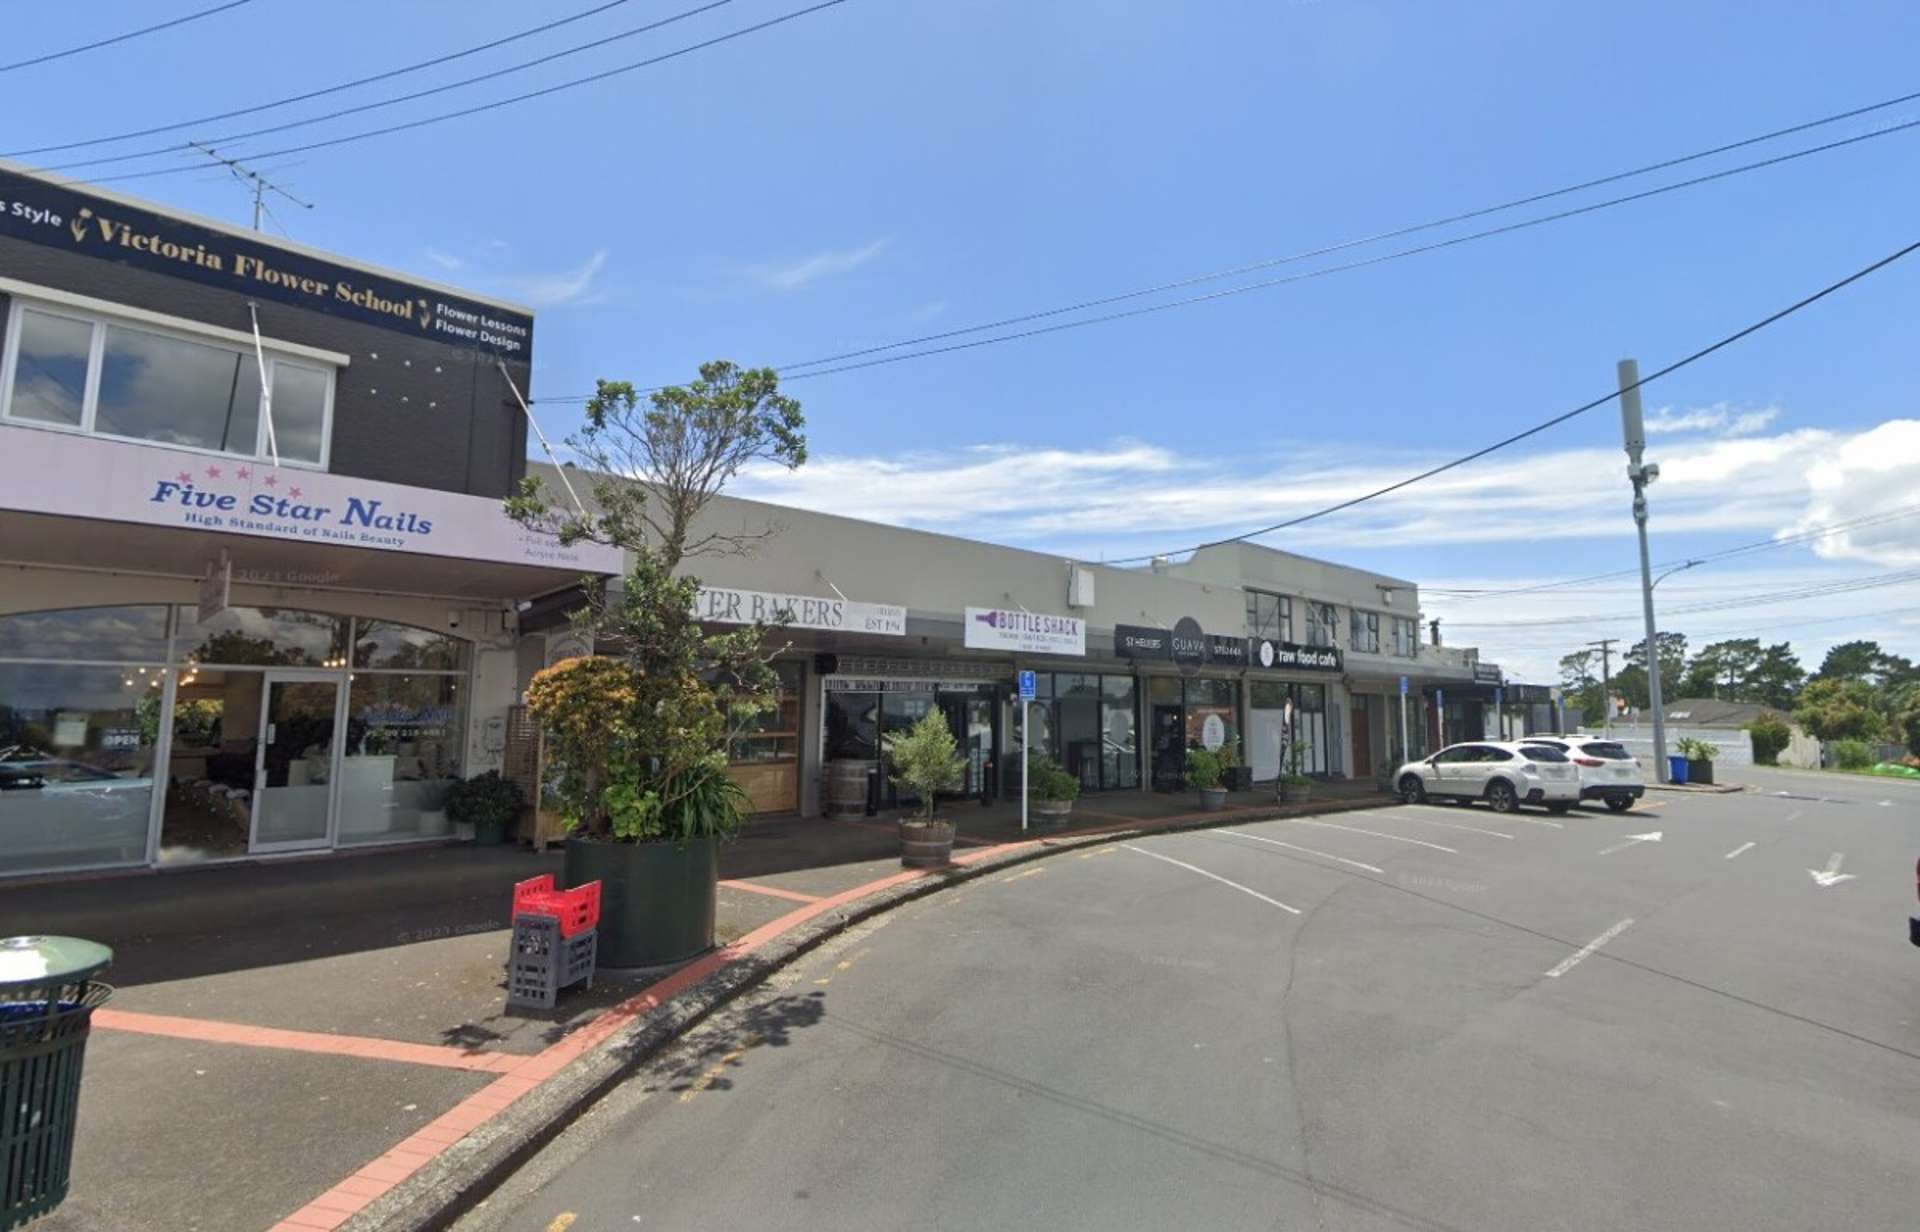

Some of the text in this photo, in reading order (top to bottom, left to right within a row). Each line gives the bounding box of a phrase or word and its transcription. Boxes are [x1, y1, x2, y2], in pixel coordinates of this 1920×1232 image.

[11, 201, 63, 227] Style
[96, 216, 413, 319] Victoria Flower School
[435, 319, 521, 351] Flower Design
[436, 303, 527, 337] Flower Lessons
[150, 481, 433, 535] Five Star Nails
[184, 513, 404, 548] High Standard of Nails Beauty
[752, 594, 843, 626] BAKERS
[1000, 611, 1079, 636] BOTTLE SHACK
[1172, 638, 1204, 650] GUAVA
[1280, 649, 1337, 667] raw food cafe
